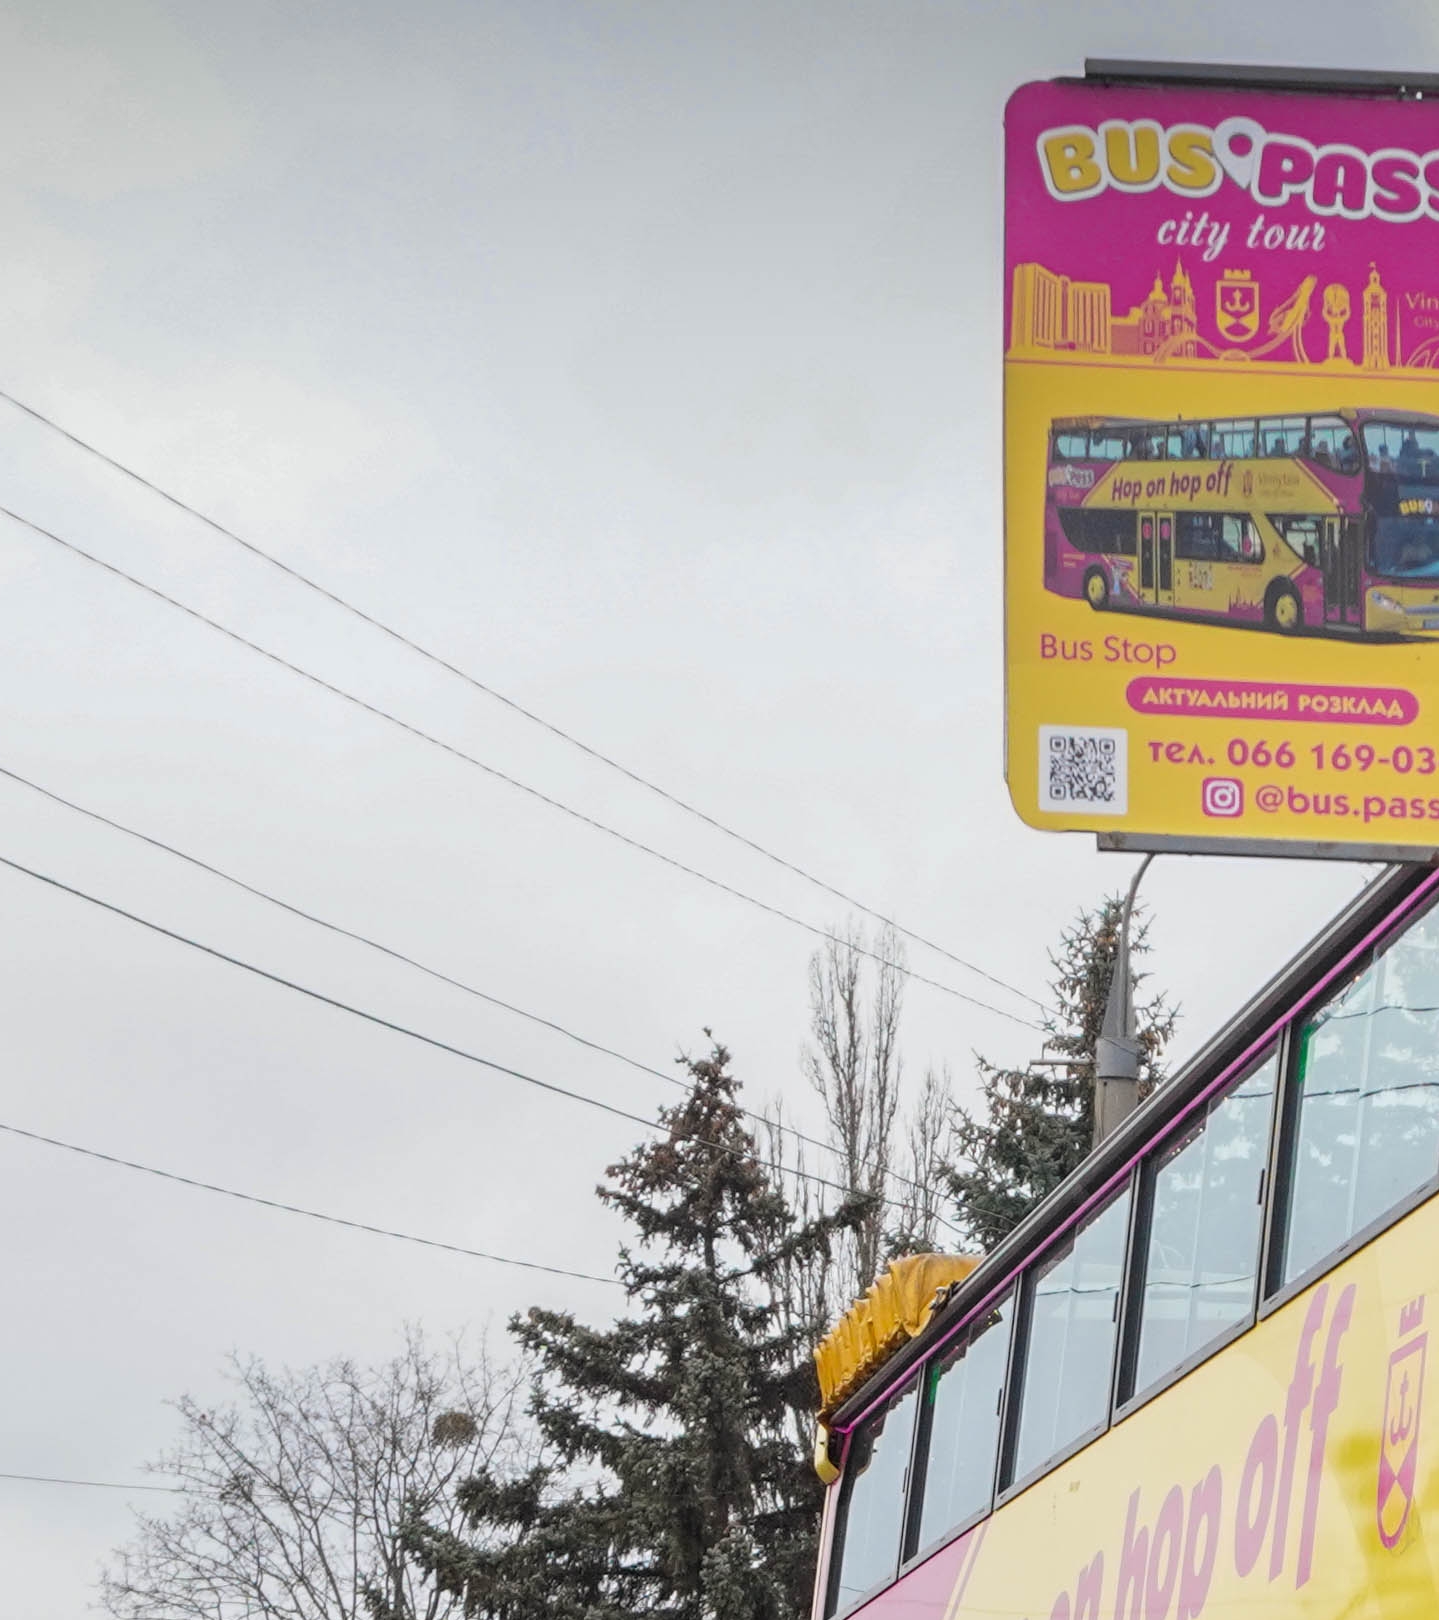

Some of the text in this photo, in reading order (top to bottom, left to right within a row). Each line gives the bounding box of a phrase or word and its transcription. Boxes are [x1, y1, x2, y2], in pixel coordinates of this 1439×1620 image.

[1037, 119, 1220, 201] BUS
[1157, 211, 1326, 262] city tour
[1112, 478, 1141, 504] Hop
[1146, 479, 1165, 498] on
[1170, 471, 1200, 501] hop
[1206, 460, 1234, 496] off
[1040, 634, 1177, 670] Bus Stop
[1142, 682, 1404, 719] АКТУАЛЬНИЙ РОЗКЛАД
[1148, 738, 1215, 767] тел.
[1226, 739, 1295, 770] 066
[1235, 1281, 1357, 1590] off
